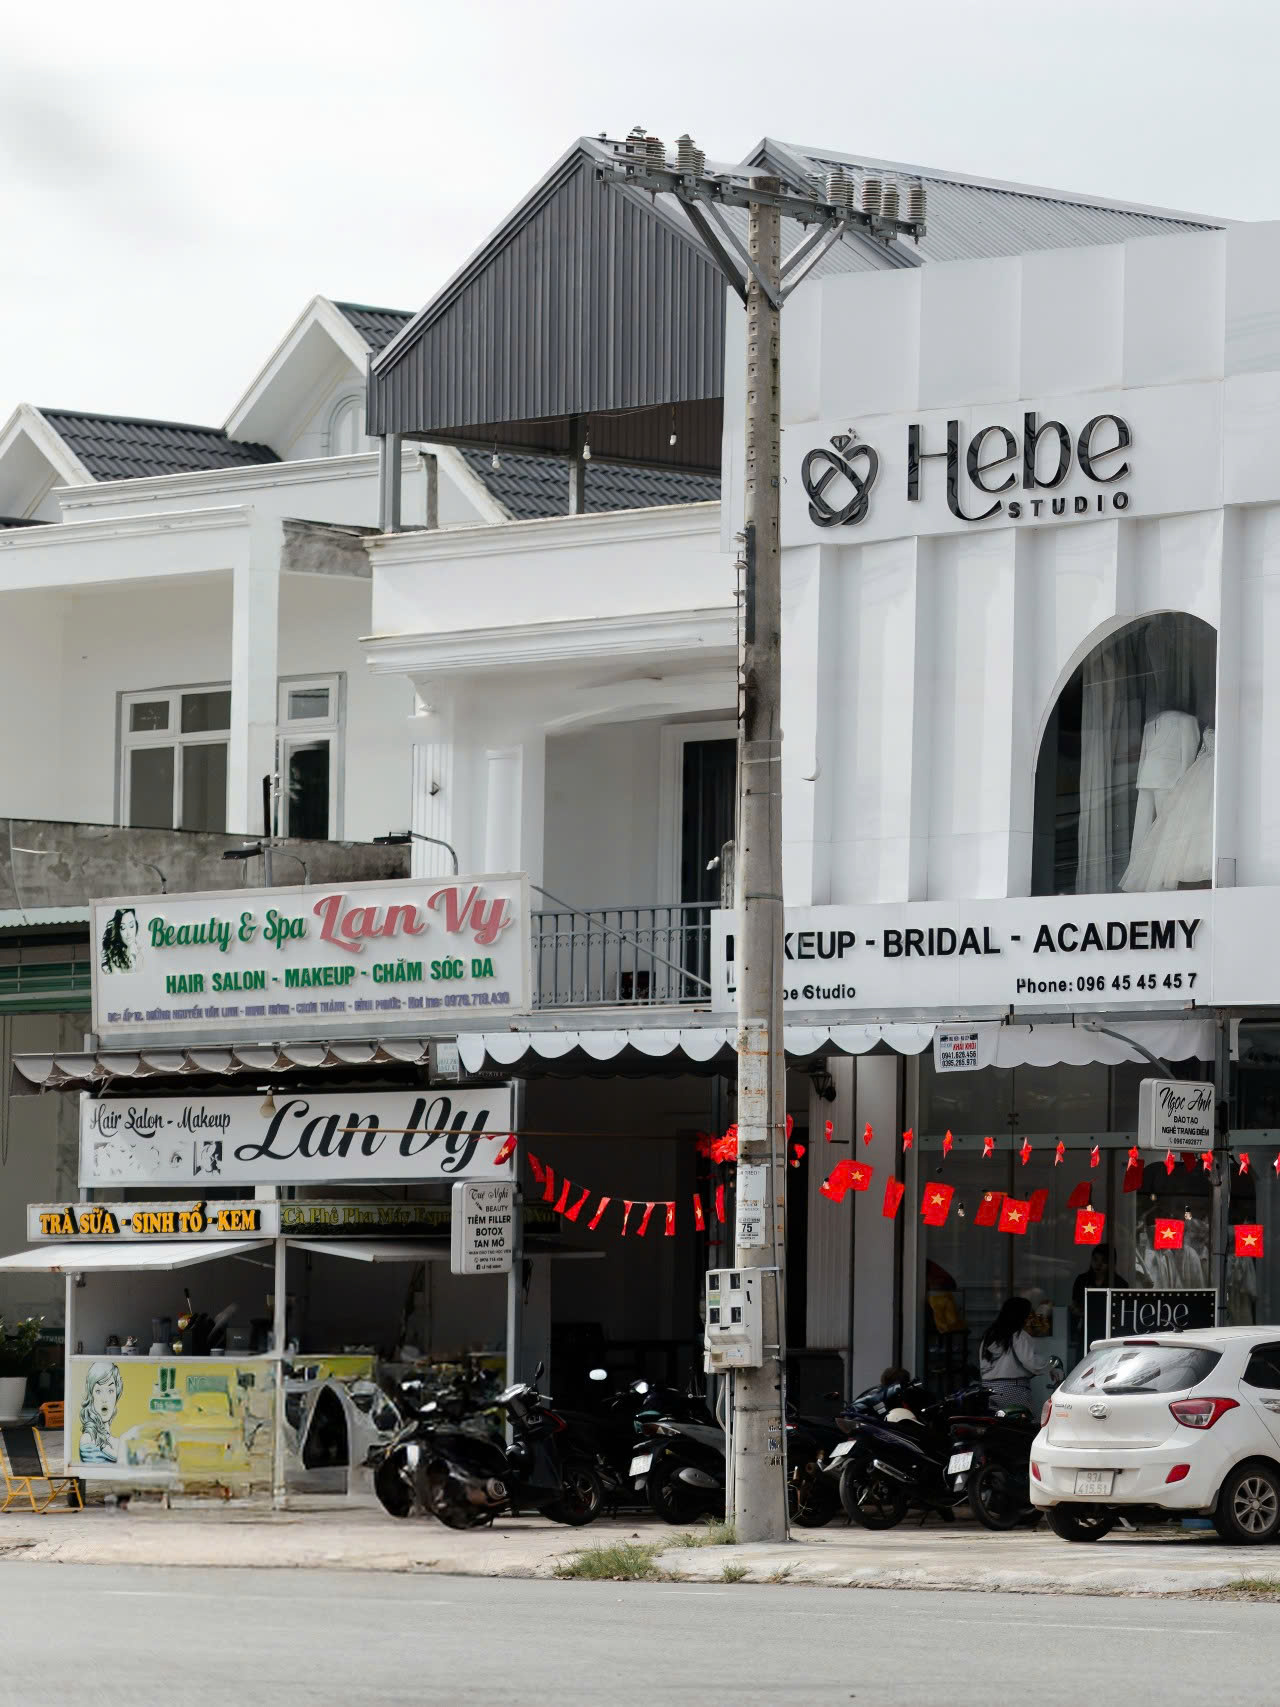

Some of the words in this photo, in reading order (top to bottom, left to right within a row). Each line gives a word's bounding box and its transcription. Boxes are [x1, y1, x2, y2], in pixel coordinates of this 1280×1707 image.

[907, 411, 1133, 521] Hebe
[1007, 491, 1130, 519] STUDIO
[148, 916, 233, 953] Beauty
[263, 909, 308, 950] Spa
[313, 894, 428, 954] Lan
[427, 885, 512, 946] Vy
[882, 926, 1001, 959] BRIDAL
[1033, 918, 1202, 955] ACADEMY
[165, 973, 205, 995] HAIR
[212, 969, 267, 993] SALON
[284, 964, 357, 989] MAKEUP
[371, 957, 423, 985] CHĂM
[430, 953, 465, 981] SÓC
[471, 957, 495, 979] DA
[1016, 977, 1073, 994] Phone:
[1076, 975, 1105, 991] 096
[1111, 974, 1131, 991] 45
[1136, 973, 1157, 990] 45
[1162, 972, 1183, 989] 45
[1187, 972, 1198, 988] 7
[802, 983, 857, 1000] Studio
[1159, 1086, 1186, 1118] Ngọc
[90, 1103, 122, 1138] Hair
[124, 1106, 164, 1139] Salon
[177, 1105, 231, 1135] Makeup
[233, 1099, 387, 1162] Lan
[398, 1096, 491, 1174] Vy
[38, 1207, 77, 1235] TRÀ
[78, 1207, 118, 1235] SỮA
[131, 1211, 178, 1234] SINH
[178, 1201, 207, 1233] TỐ
[216, 1209, 258, 1232] KEM
[467, 1214, 487, 1225] TIÊM
[488, 1215, 512, 1224] FILLER
[485, 1205, 509, 1213] BEAUTY
[473, 1239, 490, 1249] TAN
[476, 1227, 504, 1237] BOTOX
[741, 1223, 754, 1234] 75
[1120, 1298, 1190, 1334] Hebe
